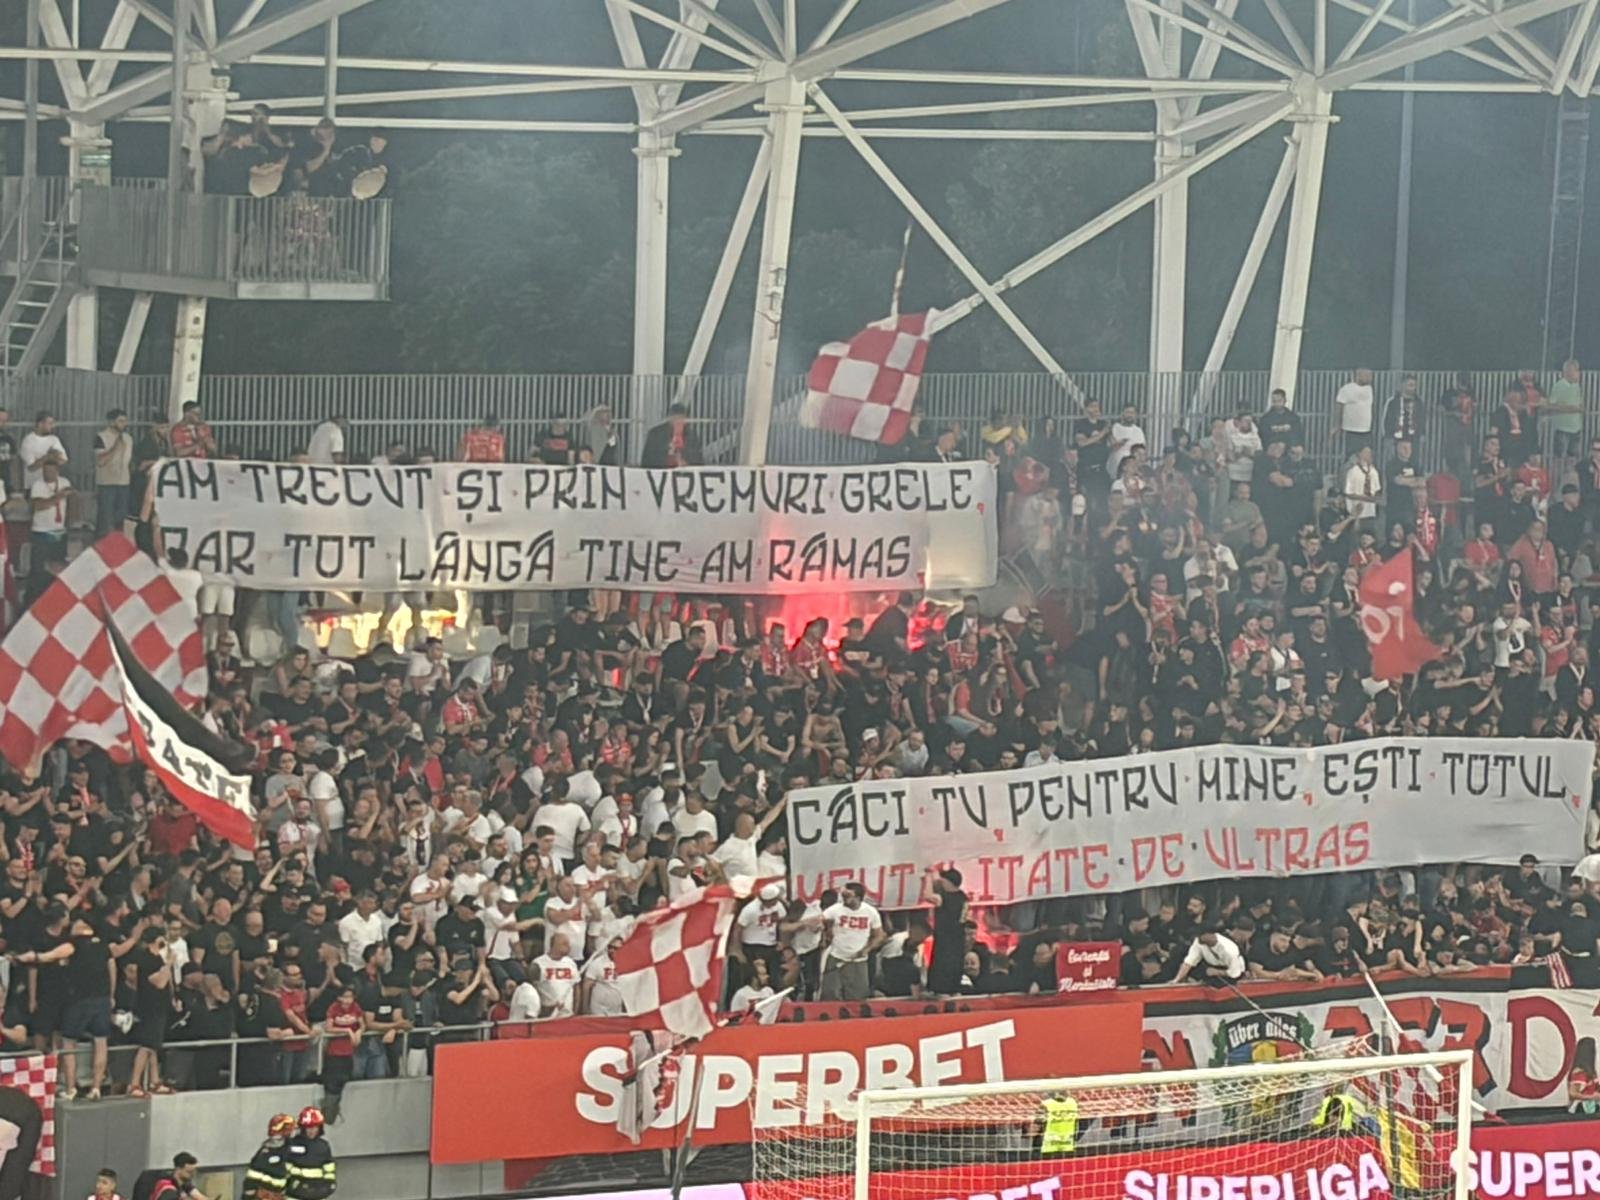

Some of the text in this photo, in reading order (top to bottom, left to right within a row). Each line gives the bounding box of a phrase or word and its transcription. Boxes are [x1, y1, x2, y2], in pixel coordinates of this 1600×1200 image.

[156, 459, 219, 501] AM
[241, 464, 432, 510] TRECUT
[525, 465, 627, 511] PRIN
[646, 469, 825, 514] VREMURI
[284, 533, 375, 579] TOT
[580, 539, 681, 583] TINE
[701, 540, 753, 583] AM
[1008, 762, 1178, 827] PENTRU
[1131, 833, 1185, 882] DE
[1204, 821, 1370, 871] ULTRAS
[576, 1020, 1016, 1130] SUPERBET
